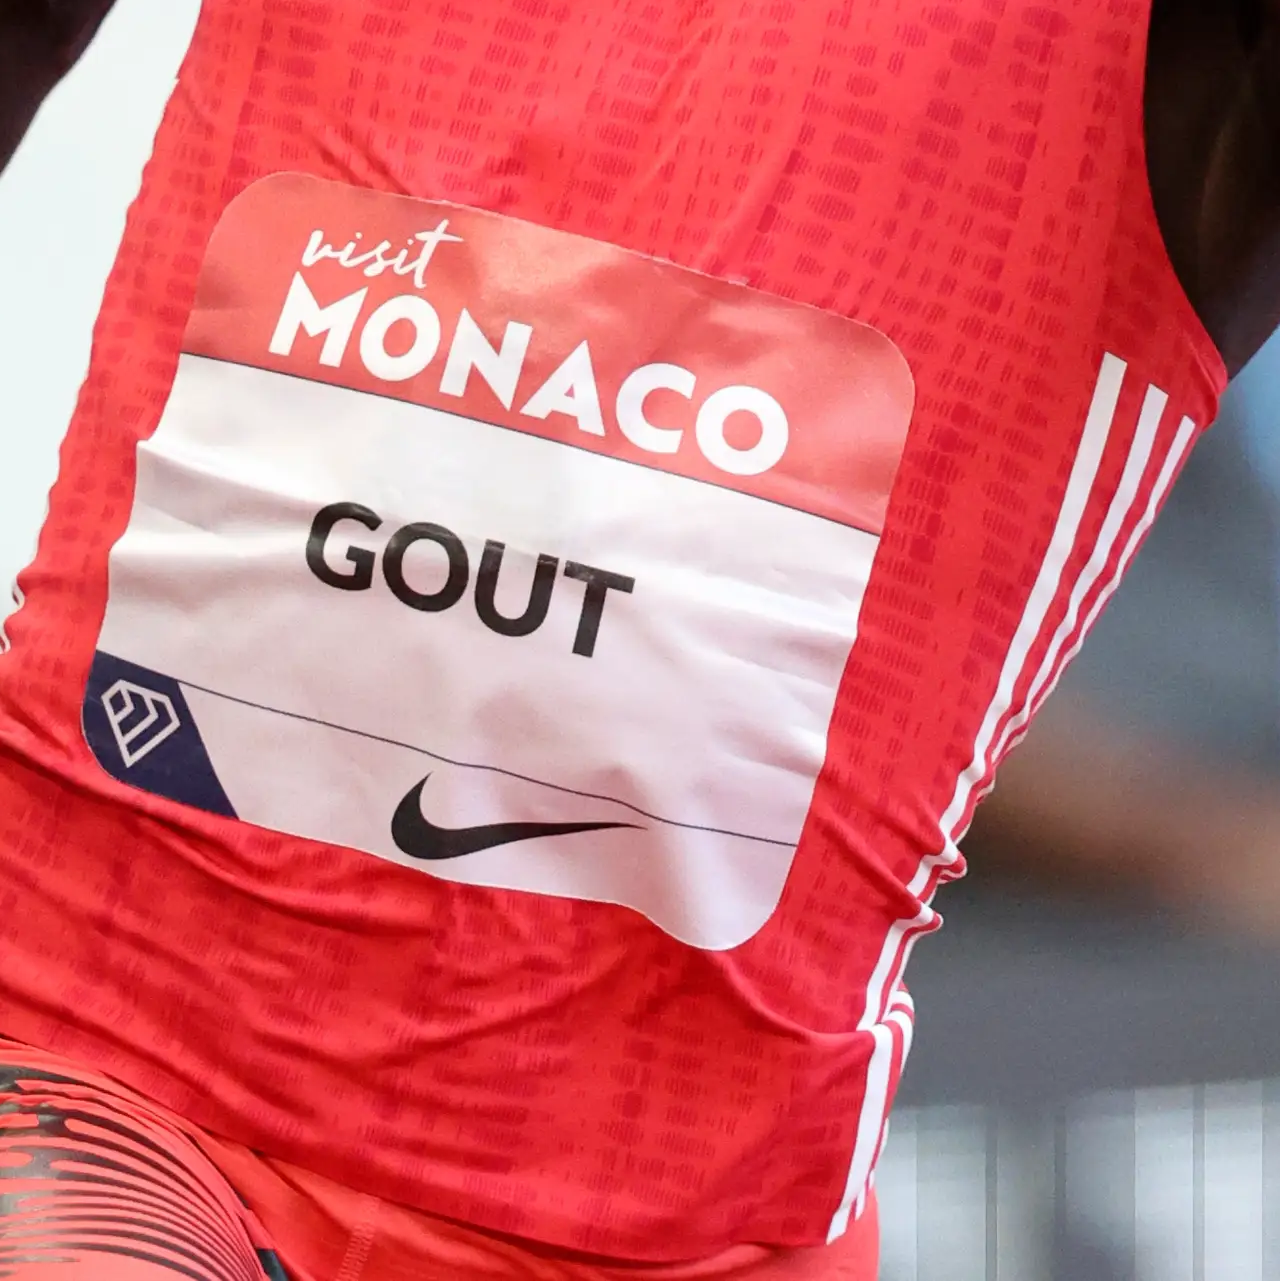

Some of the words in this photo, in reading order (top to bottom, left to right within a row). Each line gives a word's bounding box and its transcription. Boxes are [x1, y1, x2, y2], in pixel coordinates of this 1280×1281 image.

[301, 219, 463, 289] visit
[268, 272, 789, 476] MONACO
[305, 501, 635, 658] GOUT
